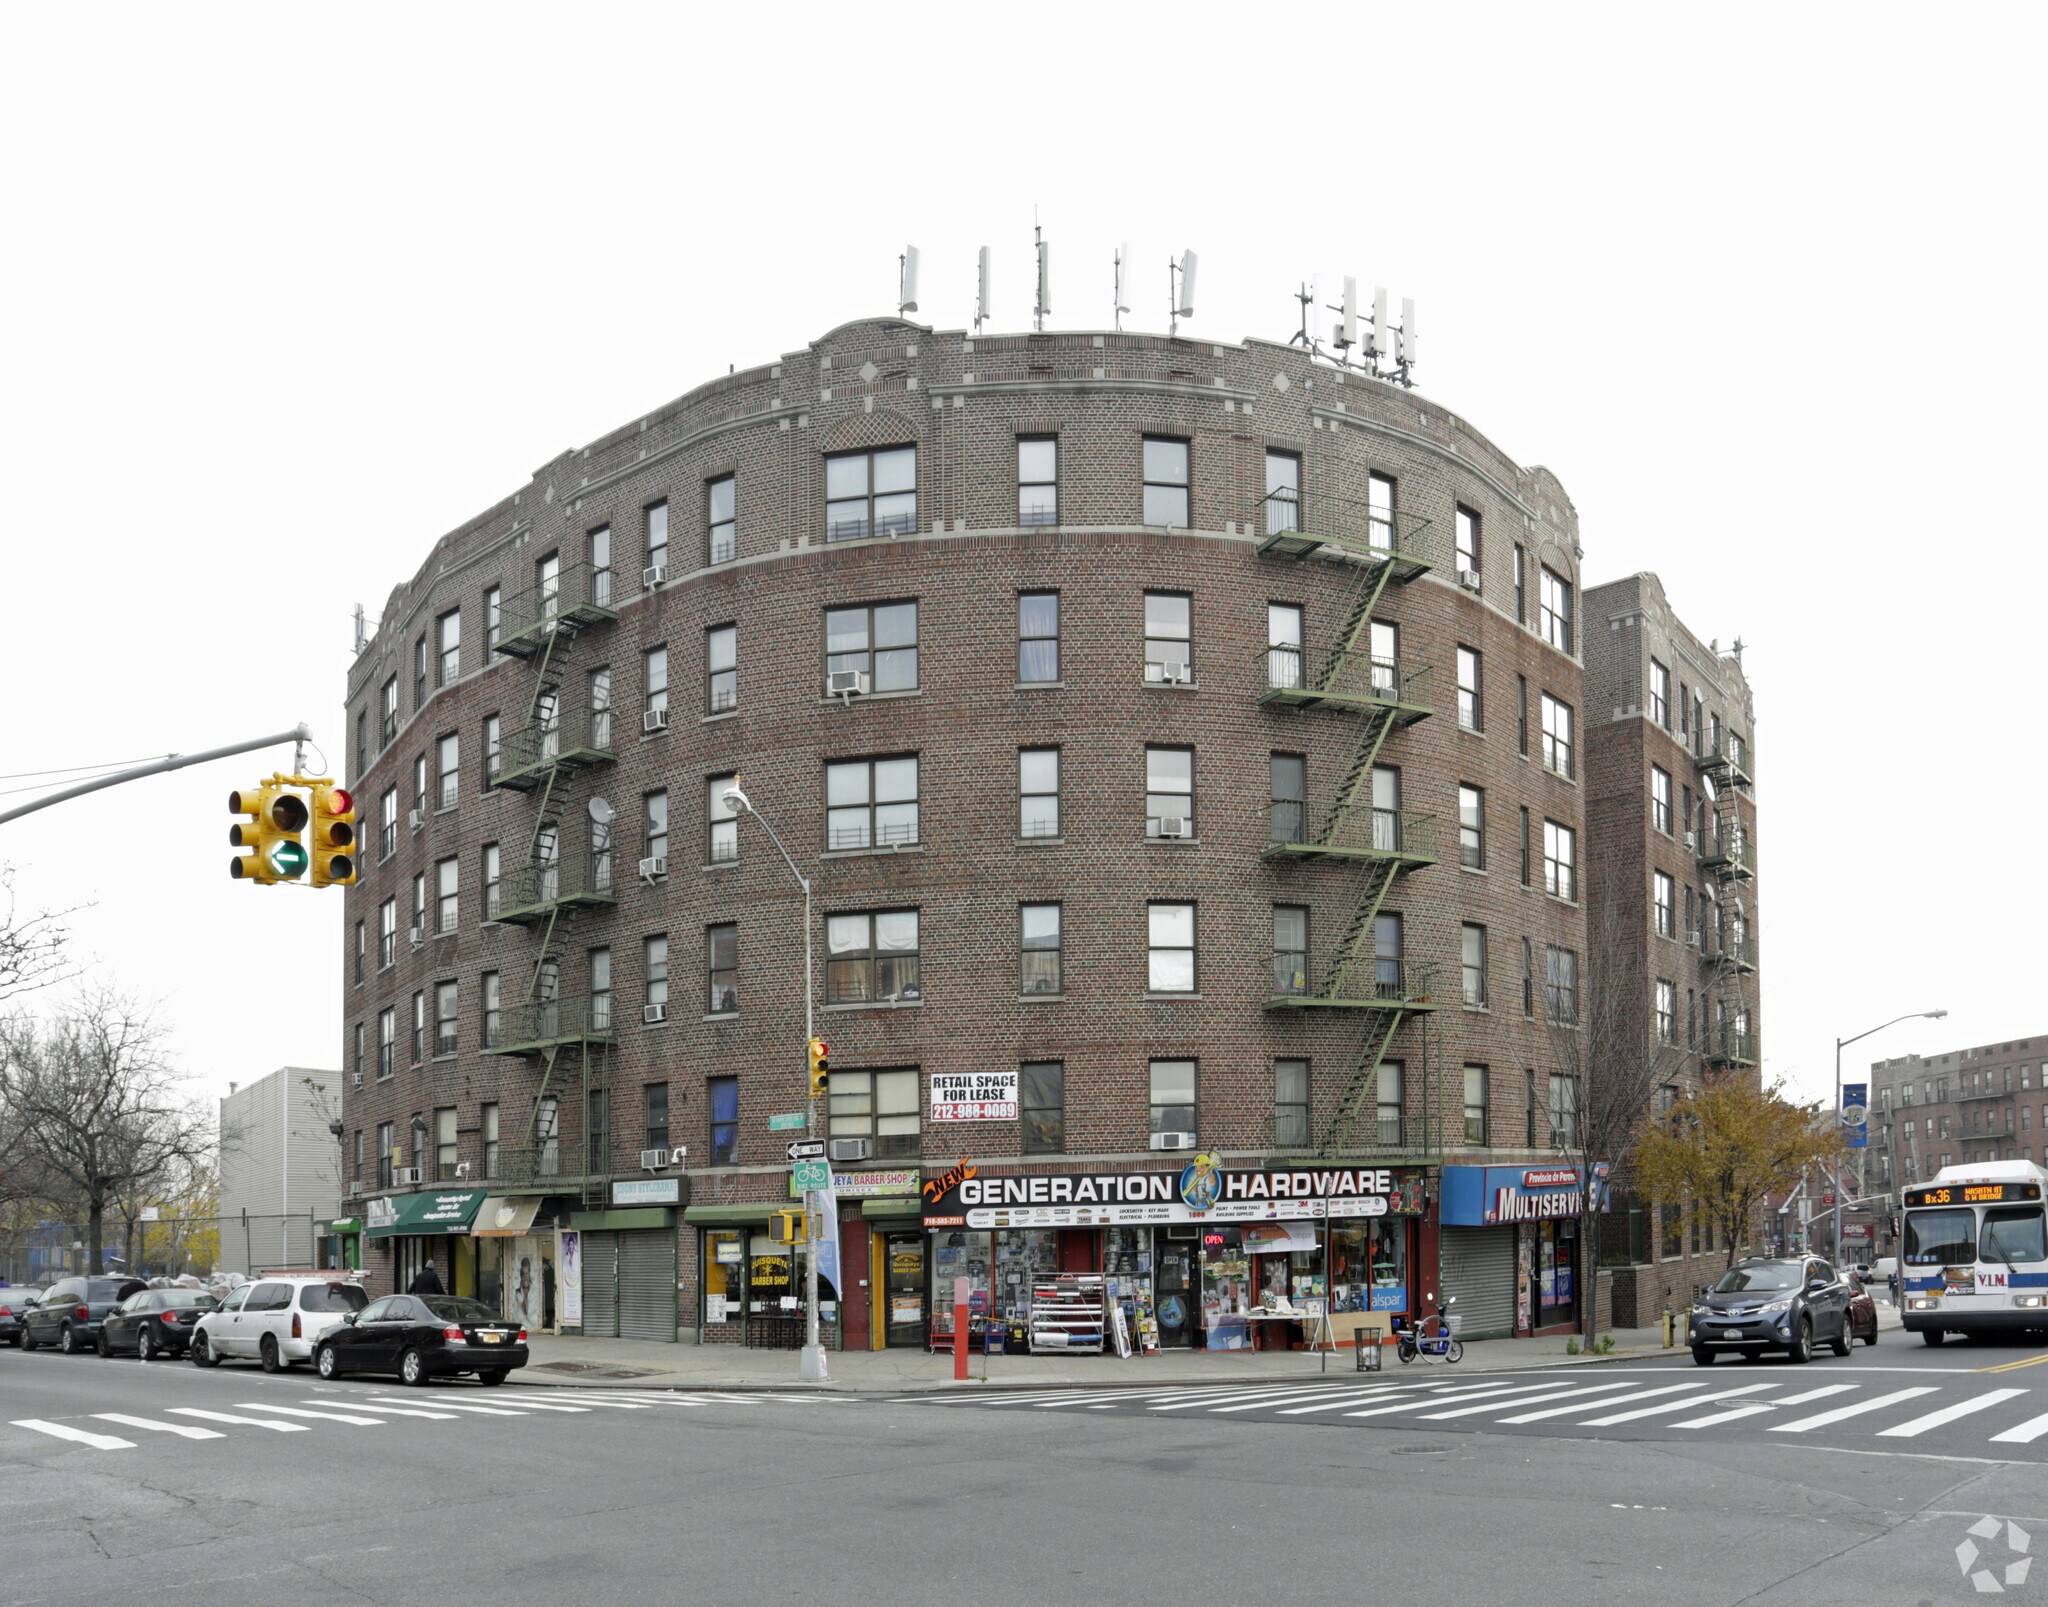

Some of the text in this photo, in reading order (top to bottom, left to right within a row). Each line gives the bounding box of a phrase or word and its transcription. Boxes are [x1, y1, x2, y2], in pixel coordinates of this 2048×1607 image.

[933, 1075, 1016, 1089] RETAIL SPACE
[943, 1088, 1005, 1101] FOR LEASE
[933, 1103, 1015, 1119] 212-988-0089
[791, 1145, 822, 1155] ONE WAY
[854, 1174, 885, 1185] BARBER
[886, 1173, 908, 1184] SHOP
[932, 1164, 966, 1195] NEW
[1528, 1173, 1552, 1183] Provincia
[960, 1170, 1391, 1204] GENERATION HARDWARE
[1925, 1189, 1951, 1204] Bx36
[1979, 1193, 2003, 1201] BRIDGE
[1204, 1234, 1224, 1245] OPEN
[751, 1256, 788, 1270] QUISQUEYA
[1164, 1256, 1179, 1264] OPEN
[751, 1275, 789, 1286] BARBER SHOP
